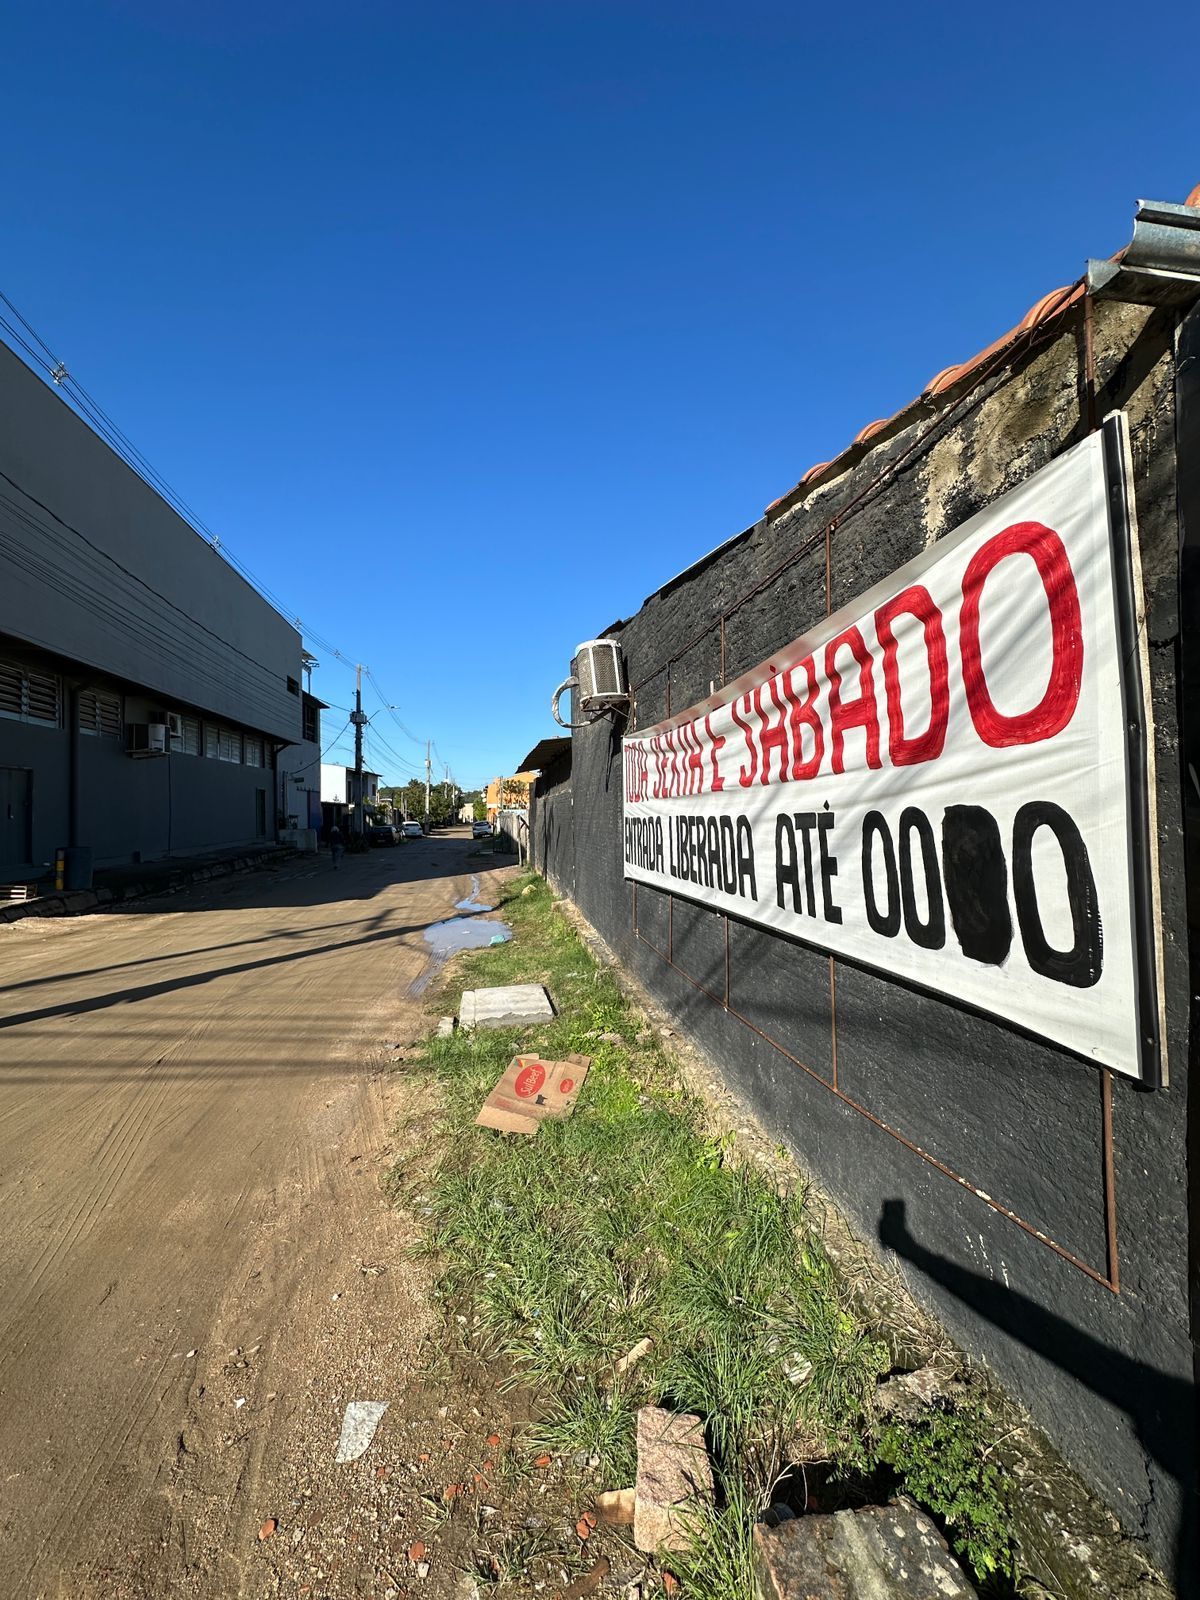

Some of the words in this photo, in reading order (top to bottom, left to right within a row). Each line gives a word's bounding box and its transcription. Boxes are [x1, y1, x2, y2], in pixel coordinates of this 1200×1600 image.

[624, 741, 649, 803] TODA
[705, 713, 726, 792] E
[731, 520, 1082, 788] SÁBADO
[624, 815, 664, 874] ENTRADA
[668, 814, 758, 902] LIBERADA
[775, 800, 843, 925] ATÉ
